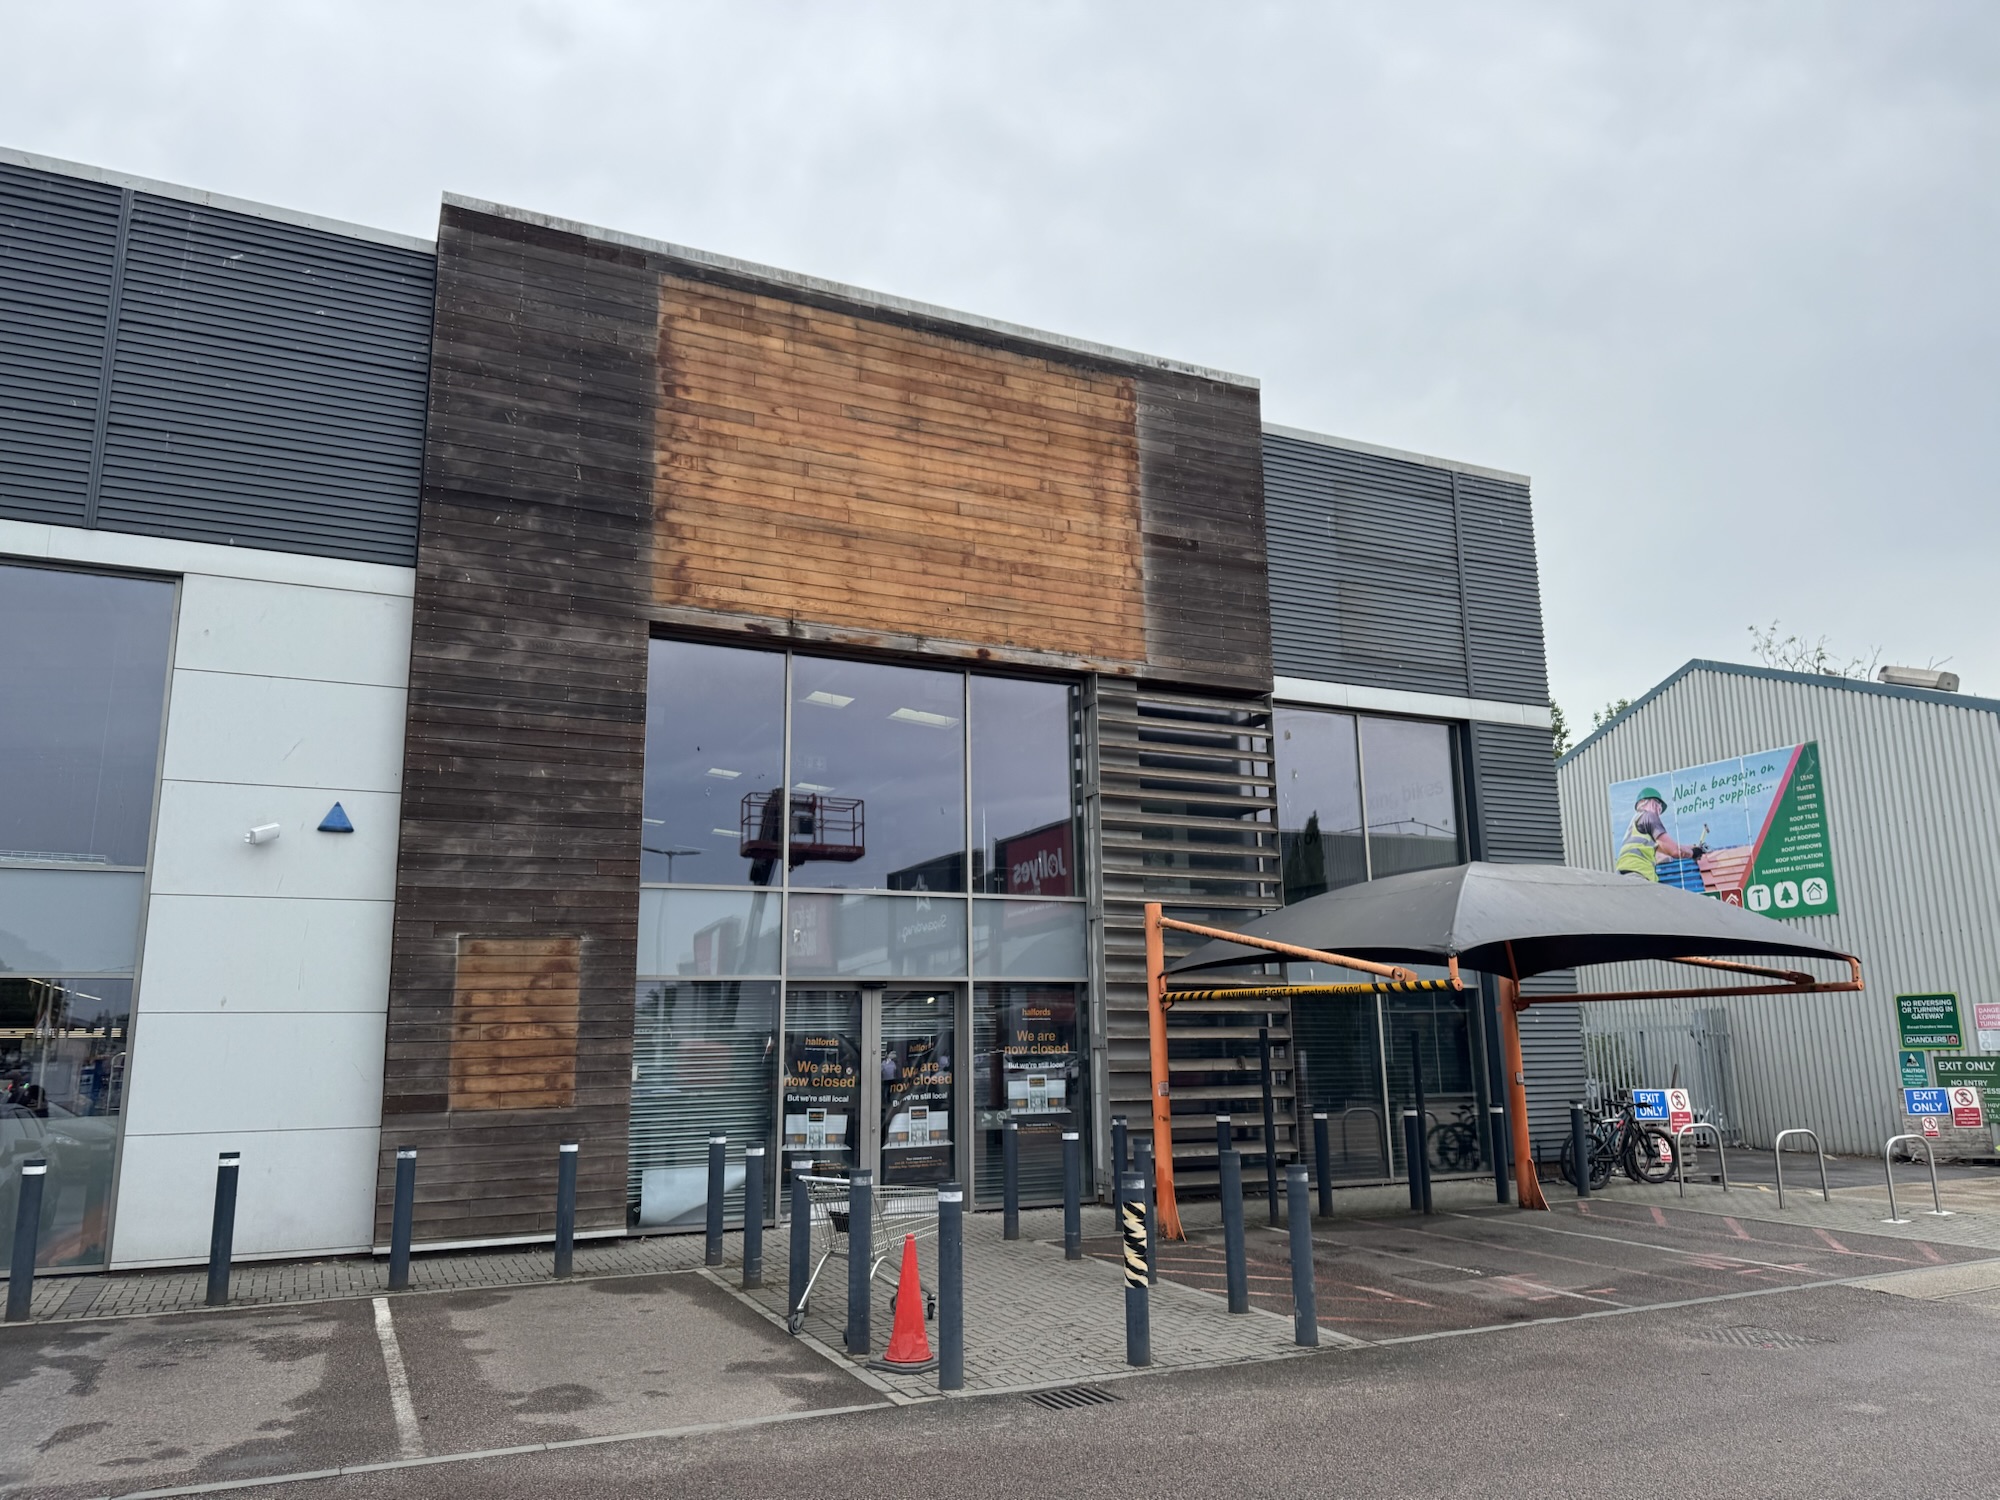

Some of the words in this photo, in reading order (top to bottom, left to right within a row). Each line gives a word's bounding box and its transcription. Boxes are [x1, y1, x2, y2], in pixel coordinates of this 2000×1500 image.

[1673, 782, 1697, 801] Nail
[1711, 767, 1756, 788] bargain
[1760, 764, 1775, 775] on
[1796, 783, 1815, 792] SLATES
[1797, 793, 1816, 801] TIMBER
[1676, 797, 1715, 815] roofing
[1797, 803, 1817, 811] BATTEN
[1790, 814, 1804, 822] ROOF
[1805, 812, 1819, 820] TILES
[1789, 822, 1820, 832] INSULATION
[1784, 834, 1797, 842] FLAT
[1797, 832, 1821, 841] ROOFING
[1781, 844, 1795, 853] ROOF
[1796, 842, 1822, 851] WINDOWS
[1775, 855, 1789, 863] ROOF
[1790, 852, 1823, 862] VENTILATION
[1762, 865, 1790, 875] RAINWATER
[1795, 862, 1825, 871] GUTTERING
[1258, 988, 1287, 998] HEIGHT
[1022, 1008, 1051, 1016] halfords
[1017, 1030, 1035, 1041] We
[1037, 1032, 1056, 1041] are
[805, 1037, 839, 1047] halfords
[1004, 1045, 1028, 1054] now
[1030, 1043, 1069, 1055] closed
[797, 1060, 818, 1073] We
[821, 1063, 842, 1074] are
[920, 1062, 939, 1072] are
[1938, 1061, 1962, 1071] EXIT
[1965, 1061, 1995, 1071] ONLY
[784, 1076, 809, 1087] now
[812, 1076, 856, 1088] closed
[913, 1073, 952, 1086] closed
[787, 1094, 800, 1102] But
[800, 1094, 818, 1102] we're
[832, 1095, 849, 1103] local
[920, 1092, 931, 1100] still
[1640, 1093, 1659, 1103] EXIT
[1912, 1091, 1938, 1100] EXIT
[1640, 1106, 1663, 1116] ONLY
[1912, 1103, 1942, 1112] ONLY
